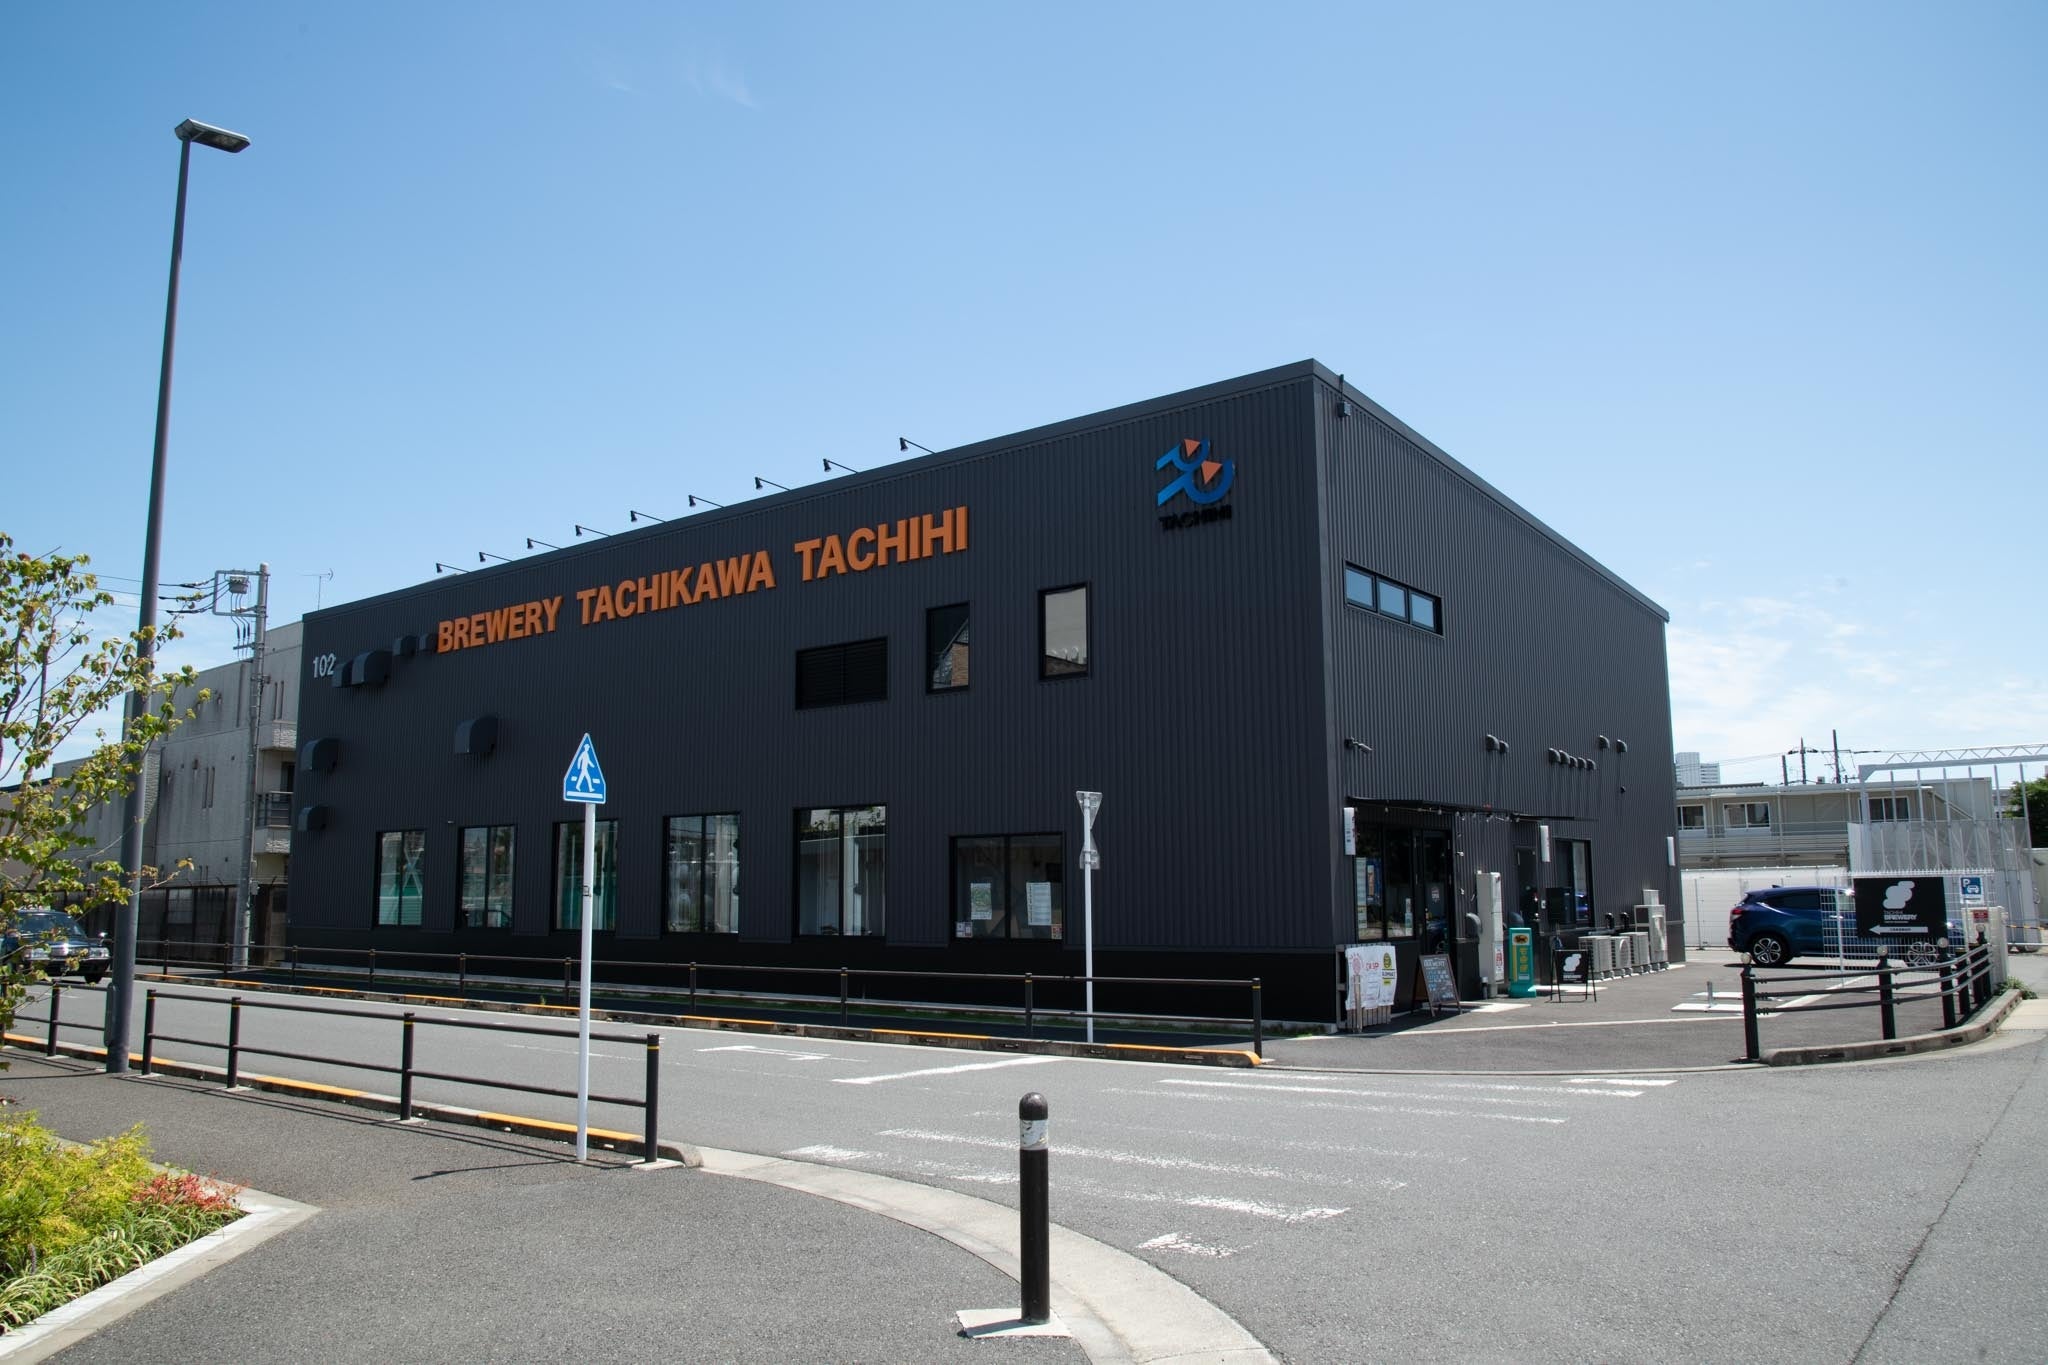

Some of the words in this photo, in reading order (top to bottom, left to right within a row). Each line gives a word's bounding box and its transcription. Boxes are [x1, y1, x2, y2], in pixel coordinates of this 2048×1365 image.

[436, 597, 563, 654] BREWERY
[576, 551, 776, 625] TACHIKAWA
[793, 507, 969, 582] TACHIHI
[312, 653, 337, 678] 102
[1963, 879, 1970, 887] P
